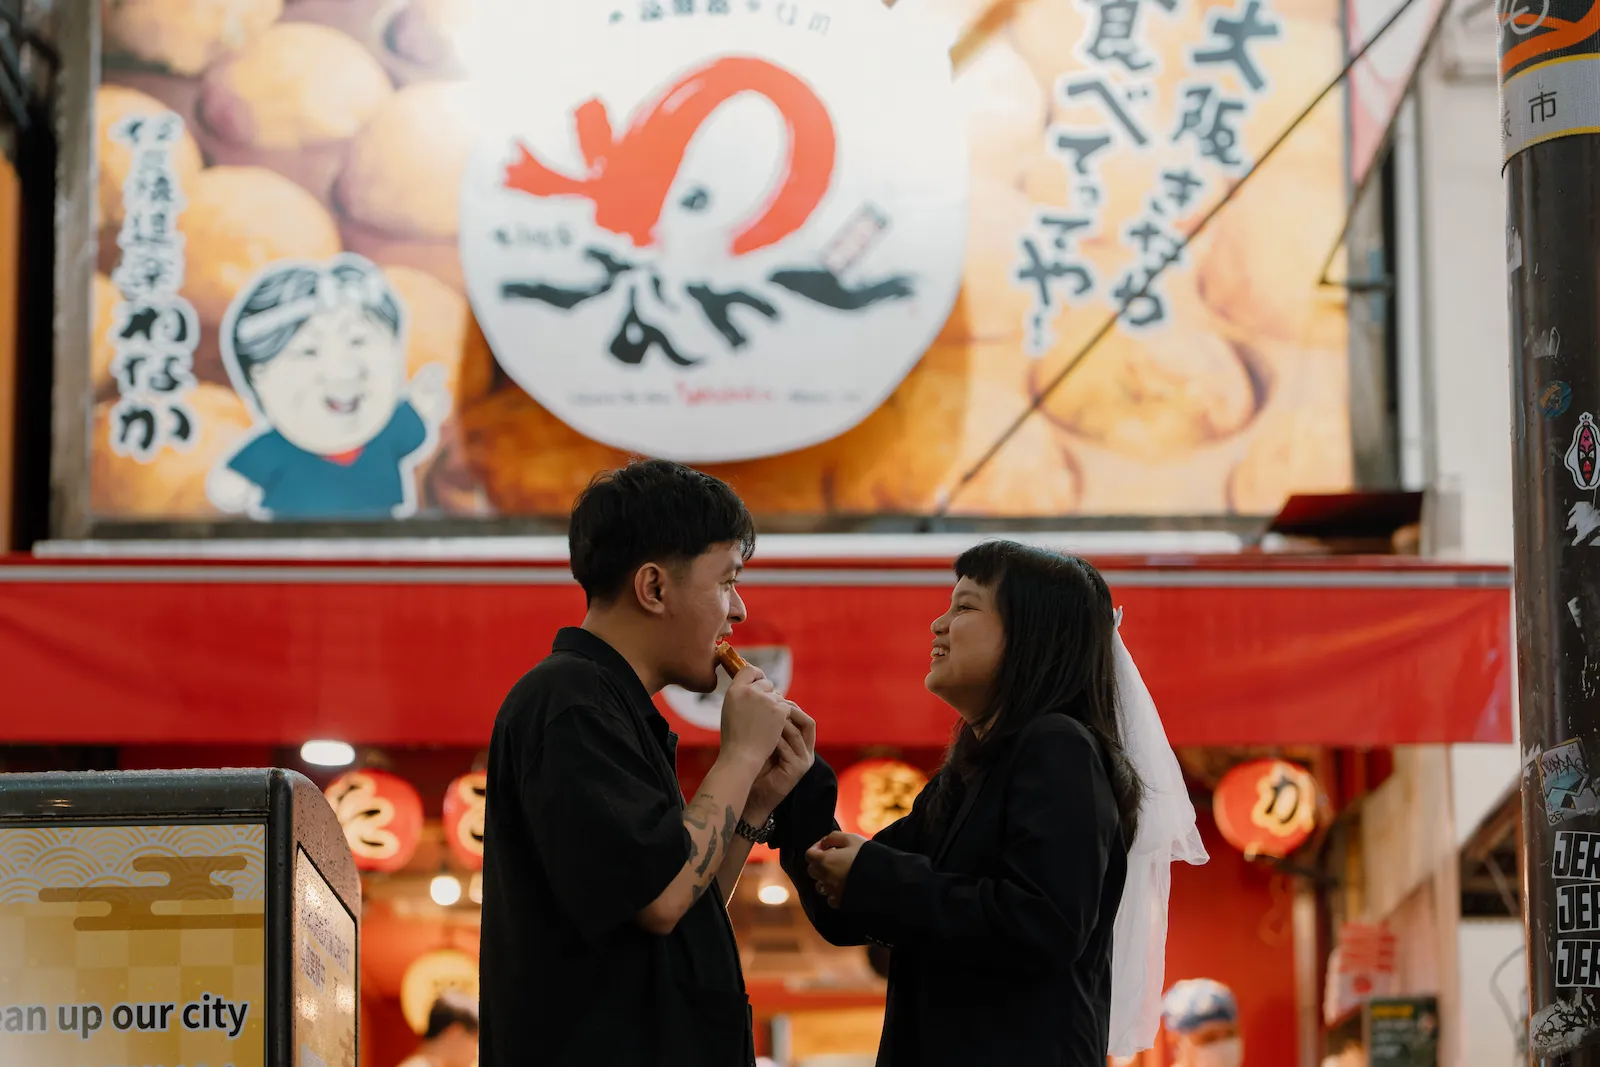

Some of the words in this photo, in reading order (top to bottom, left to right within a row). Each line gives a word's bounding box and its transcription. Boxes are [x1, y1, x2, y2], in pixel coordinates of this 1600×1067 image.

[0, 1006, 47, 1032] an
[58, 1005, 102, 1039] up
[113, 1004, 174, 1030] our
[183, 994, 248, 1037] city
